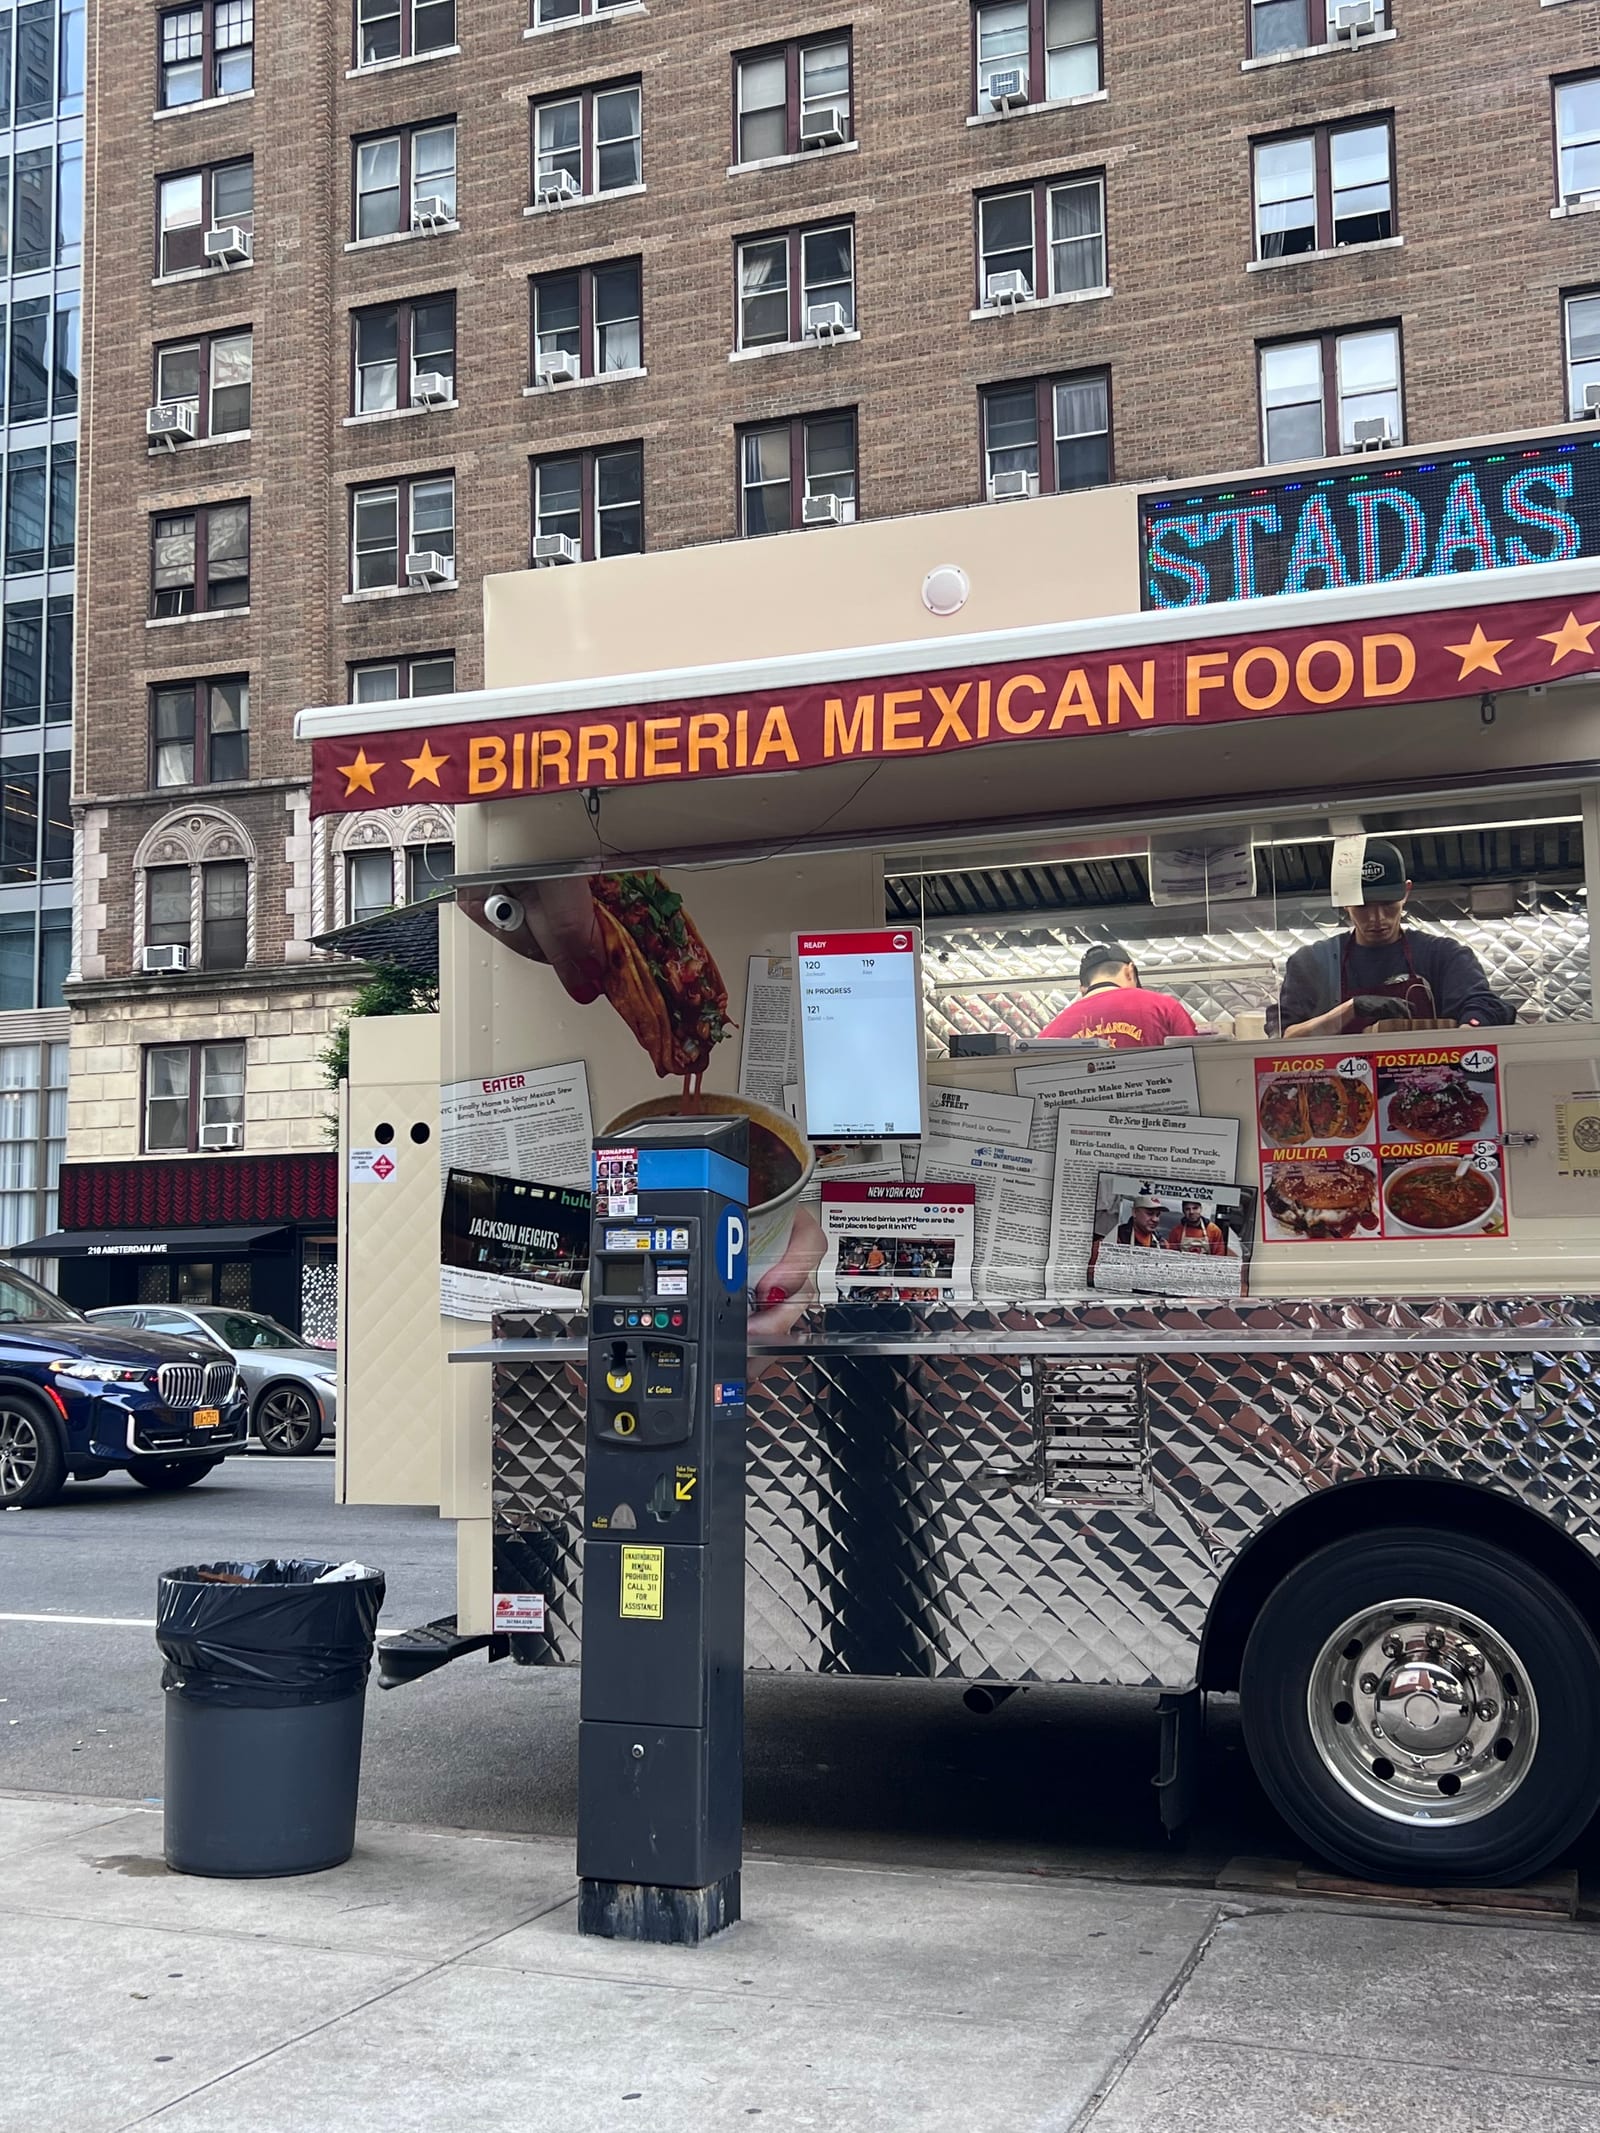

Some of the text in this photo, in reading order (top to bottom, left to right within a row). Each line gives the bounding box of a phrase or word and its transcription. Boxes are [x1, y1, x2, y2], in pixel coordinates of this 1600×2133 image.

[1148, 463, 1581, 612] STADAS
[468, 633, 1416, 795] BIRRIERIA MEXICAN FOOD
[804, 941, 827, 949] READY
[805, 959, 875, 969] 120 119
[815, 987, 852, 995] PROGRESS
[807, 1006, 820, 1014] 121
[1272, 1058, 1325, 1073] TACOS
[1376, 1051, 1460, 1068] TOSTADAS
[482, 1075, 526, 1094] EATER
[1038, 1077, 1173, 1100] Two Brothers Make New York's
[458, 1103, 480, 1112] Finally
[482, 1100, 502, 1109] Home
[511, 1095, 528, 1103] Spicy
[530, 1090, 556, 1099] Mexican
[557, 1087, 573, 1095] Stew
[942, 1093, 961, 1101] GRUB
[1080, 1093, 1114, 1104] Juiciest
[1116, 1090, 1144, 1099] Birria
[1146, 1086, 1171, 1096] Tacos
[476, 1109, 492, 1118] That
[513, 1102, 538, 1112] Versions
[547, 1098, 556, 1106] LA
[941, 1100, 969, 1110] STREET
[962, 1121, 977, 1130] Food
[986, 1125, 1011, 1134] Queens
[1108, 1114, 1187, 1129] The New York Times
[1069, 1139, 1127, 1151] Birria-Landia,
[1137, 1143, 1167, 1153] Queens
[1170, 1145, 1190, 1155] Food
[1192, 1147, 1221, 1157] Truck,
[1273, 1147, 1328, 1161] MULITA
[1380, 1142, 1459, 1157] CONSOME
[993, 1153, 1033, 1164] INFATUATION
[1075, 1148, 1216, 1166] Has Changed the Taco Landscape
[868, 1186, 925, 1199] NEW YORK POST
[1153, 1188, 1213, 1201] PUEBLA USA
[1154, 1183, 1214, 1195] FUNDACIÓN
[560, 1191, 591, 1209] hulu
[845, 1222, 868, 1230] places
[876, 1223, 888, 1231] get
[469, 1217, 560, 1250] JACKSON HEIGHTS
[88, 1244, 168, 1255] 210 AMSTERDAM AVE
[727, 1216, 744, 1280] P
[656, 1386, 672, 1394] Coins
[625, 1553, 660, 1561] UNAUTHORIZED
[625, 1573, 659, 1581] PROHIBITED
[625, 1602, 658, 1611] ASSISTANCE
